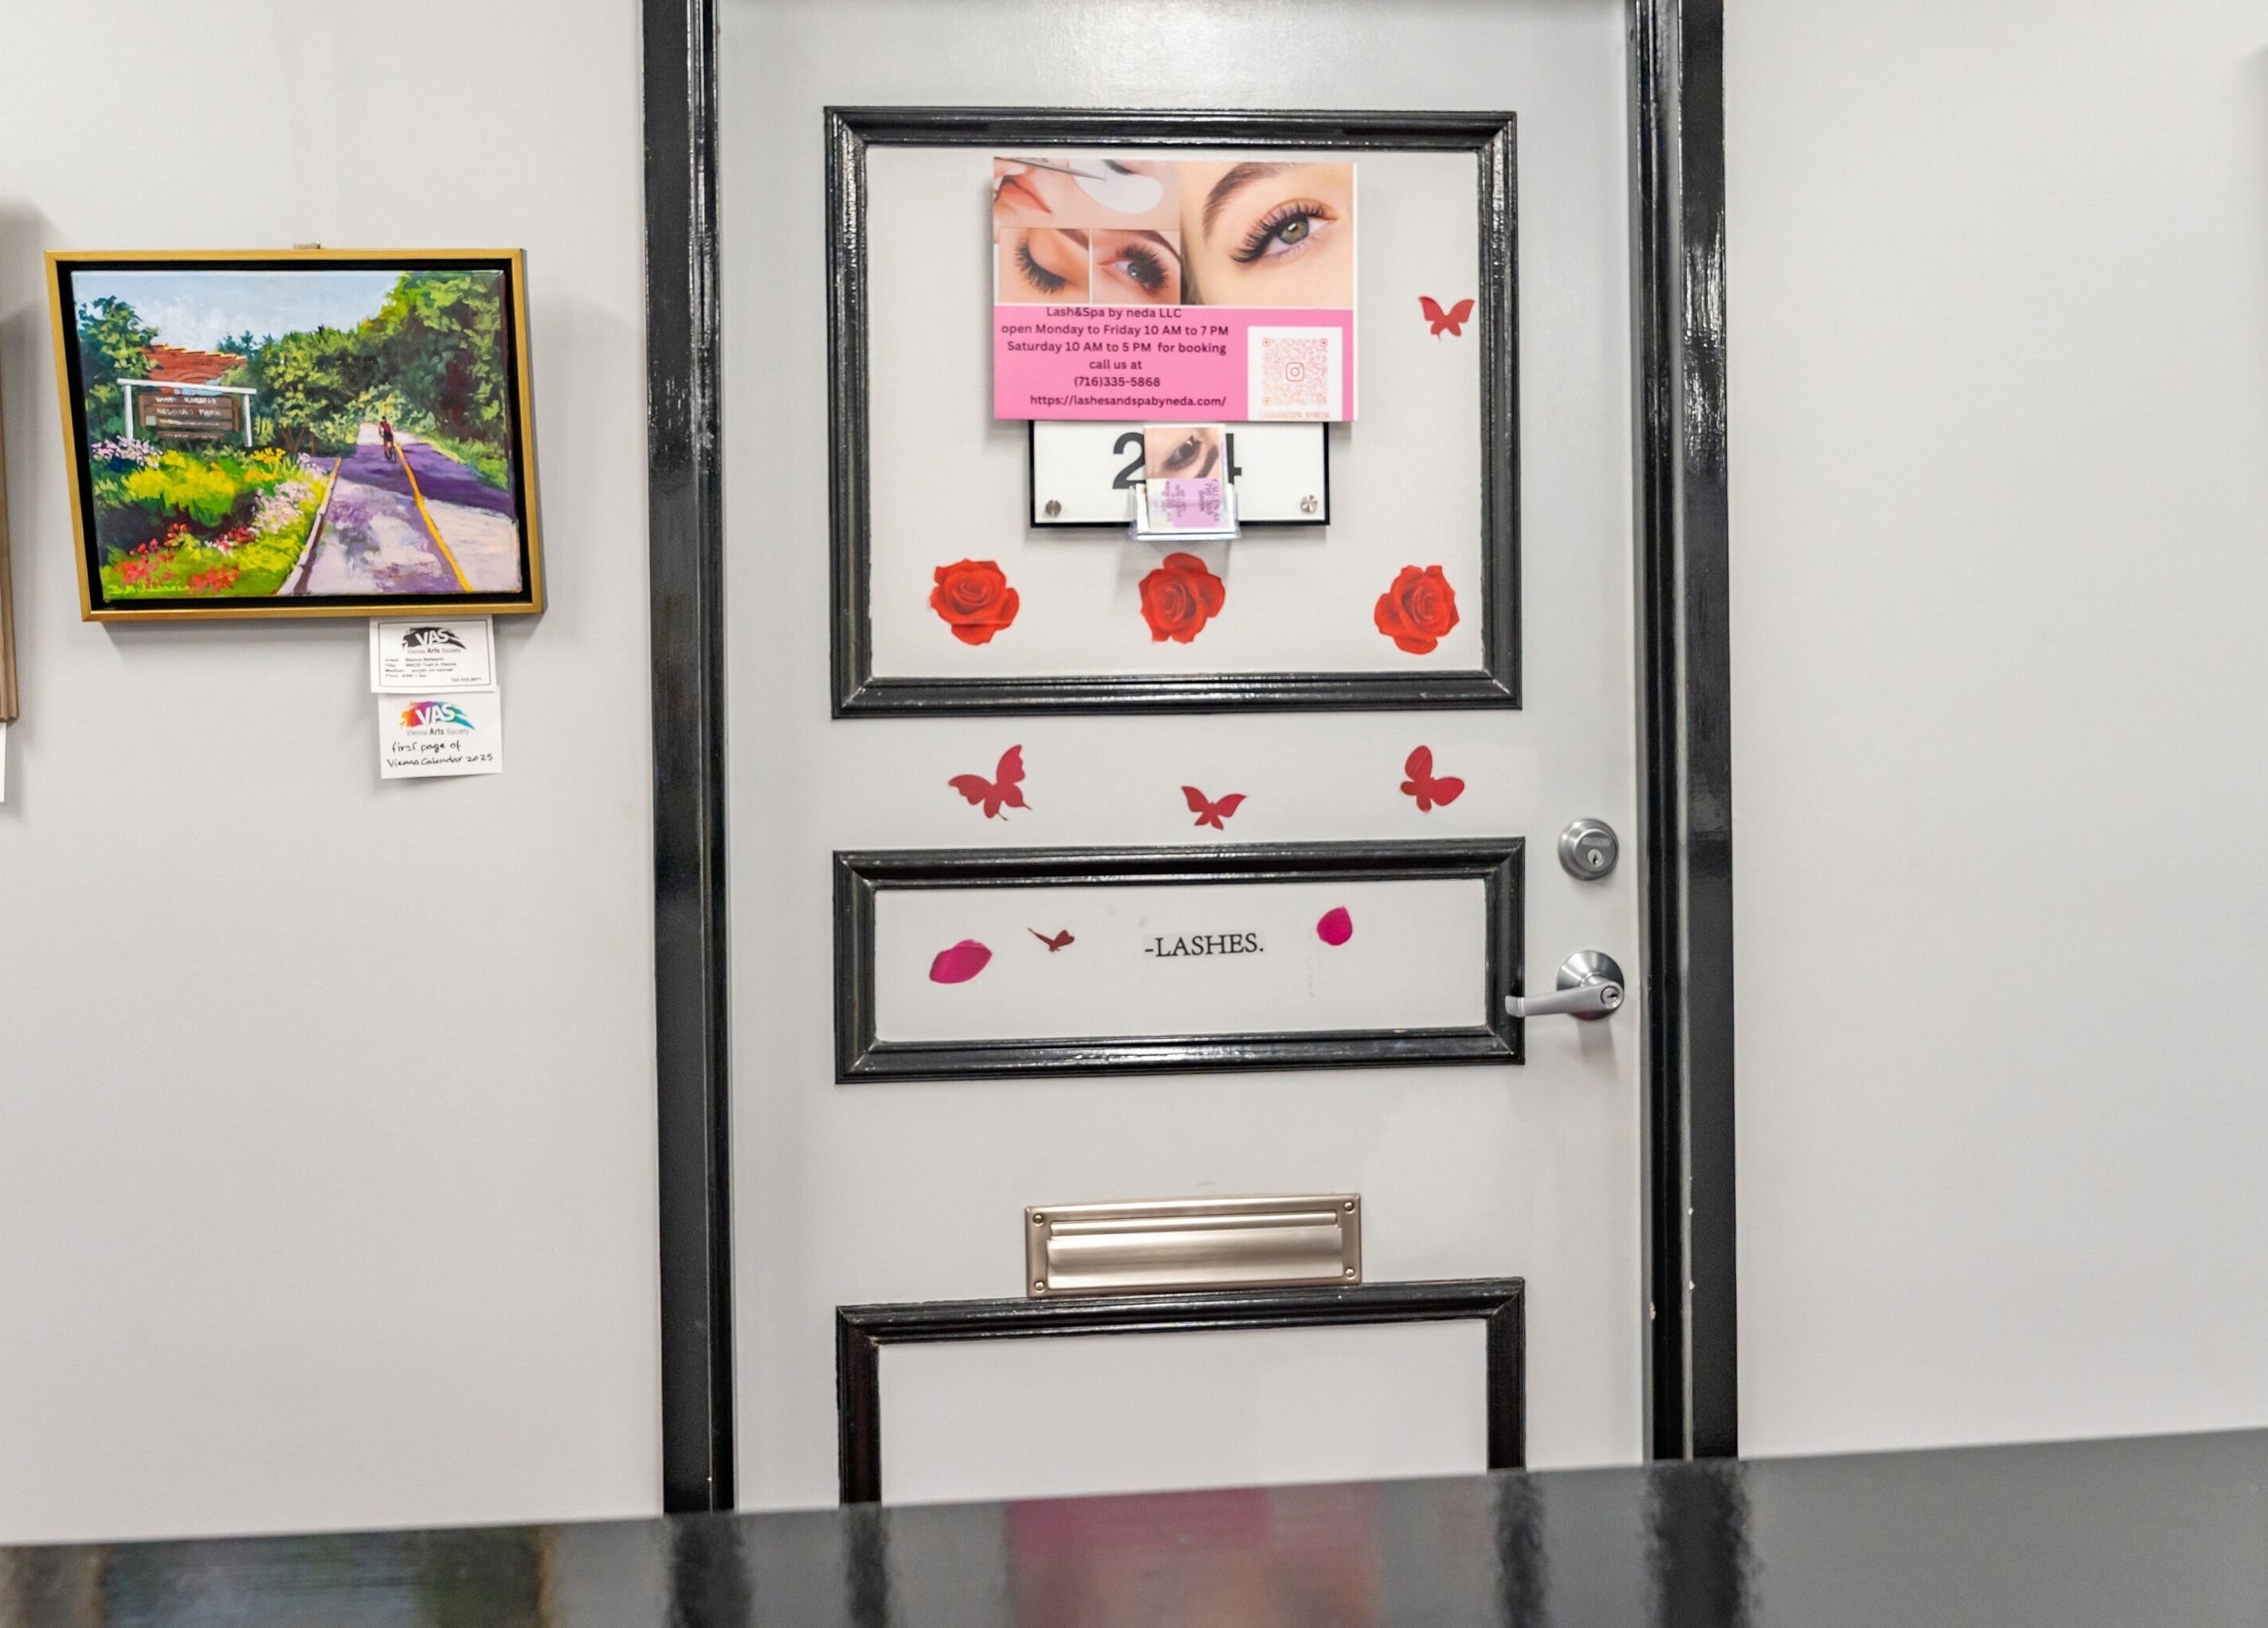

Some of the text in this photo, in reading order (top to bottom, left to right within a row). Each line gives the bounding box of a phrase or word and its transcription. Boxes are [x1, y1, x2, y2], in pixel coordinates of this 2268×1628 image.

[1046, 306, 1181, 320] Lash&Spa by neda LLC
[1001, 324, 1229, 337] open Monday to Friday 10 AM to 7 PM
[1007, 341, 1226, 355] Saturday 10 AM to 5 PM for booking
[1089, 359, 1143, 370] call us at
[1074, 376, 1160, 387] (716)335-5868
[1030, 395, 1226, 408] https://lashesandspabyneda.com/
[415, 629, 449, 646] VAS
[415, 703, 456, 725] VAS
[420, 743, 445, 754] page
[449, 740, 462, 751] of
[465, 753, 494, 763] 2025
[1144, 933, 1264, 957] -LASHES.
